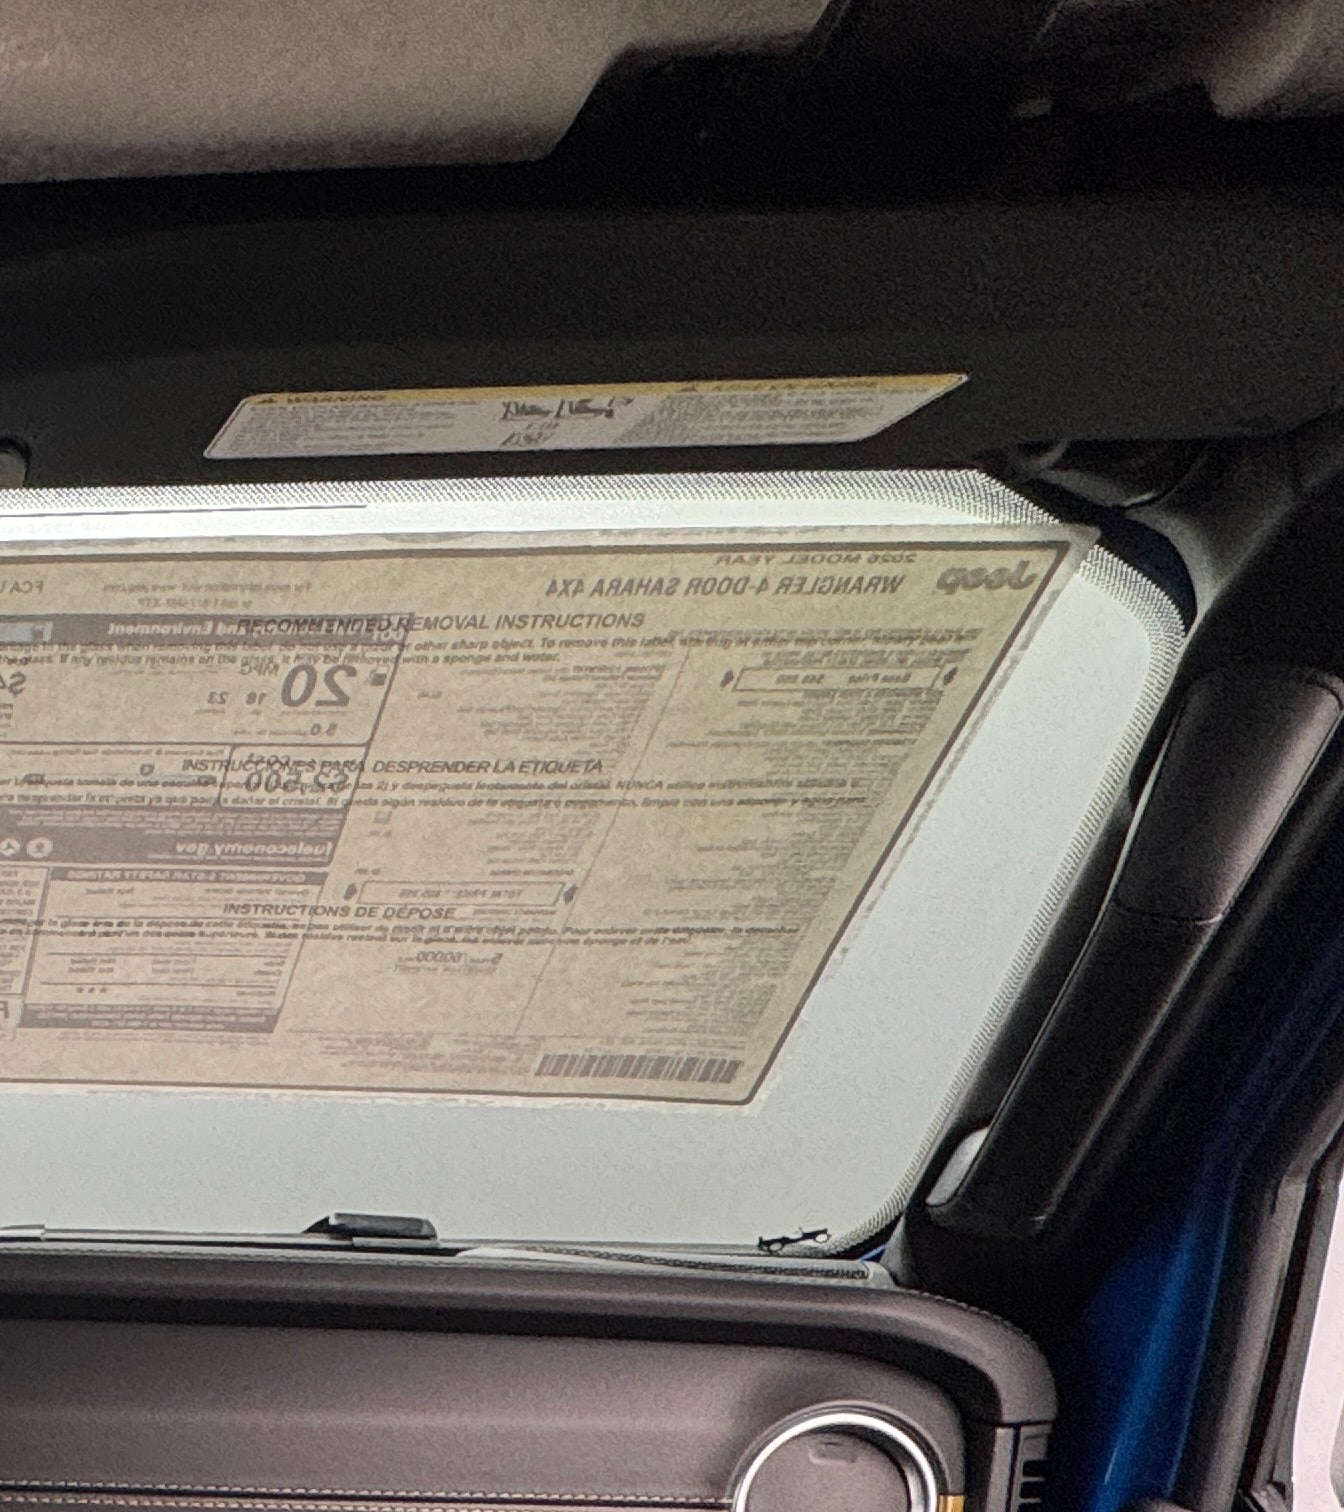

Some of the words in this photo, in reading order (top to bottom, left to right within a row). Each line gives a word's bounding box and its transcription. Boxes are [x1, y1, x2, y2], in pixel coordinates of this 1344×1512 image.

[236, 618, 392, 633] RECOMMENDED
[397, 614, 490, 631] REMOVAL
[495, 612, 645, 630] INSTRUCTIONS
[372, 759, 491, 773] DESPRENDER
[493, 759, 516, 773] LA
[518, 759, 604, 775] ETIQUETA
[223, 903, 350, 918] INSTRUCTIONS
[354, 905, 378, 918] DE
